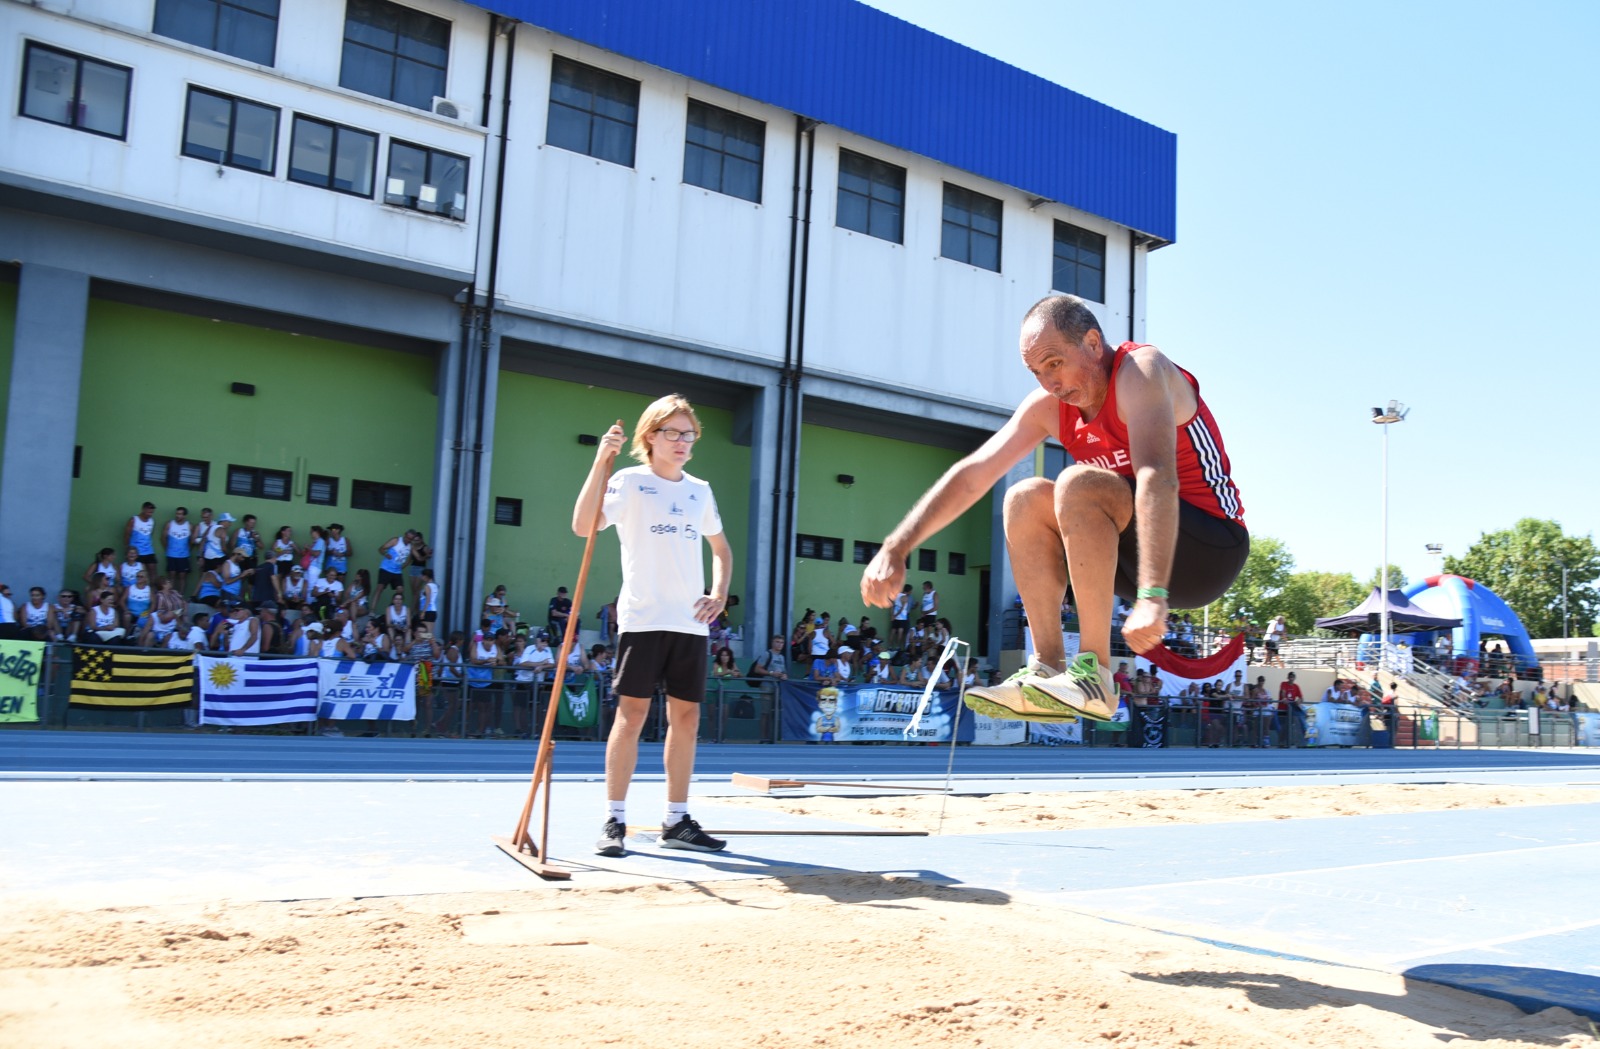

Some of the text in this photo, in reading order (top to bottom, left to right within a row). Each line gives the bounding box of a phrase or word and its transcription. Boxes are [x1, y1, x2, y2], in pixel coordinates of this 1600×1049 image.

[1076, 449, 1131, 469] HILE
[650, 524, 677, 534] osde
[325, 688, 405, 699] ASAVUR
